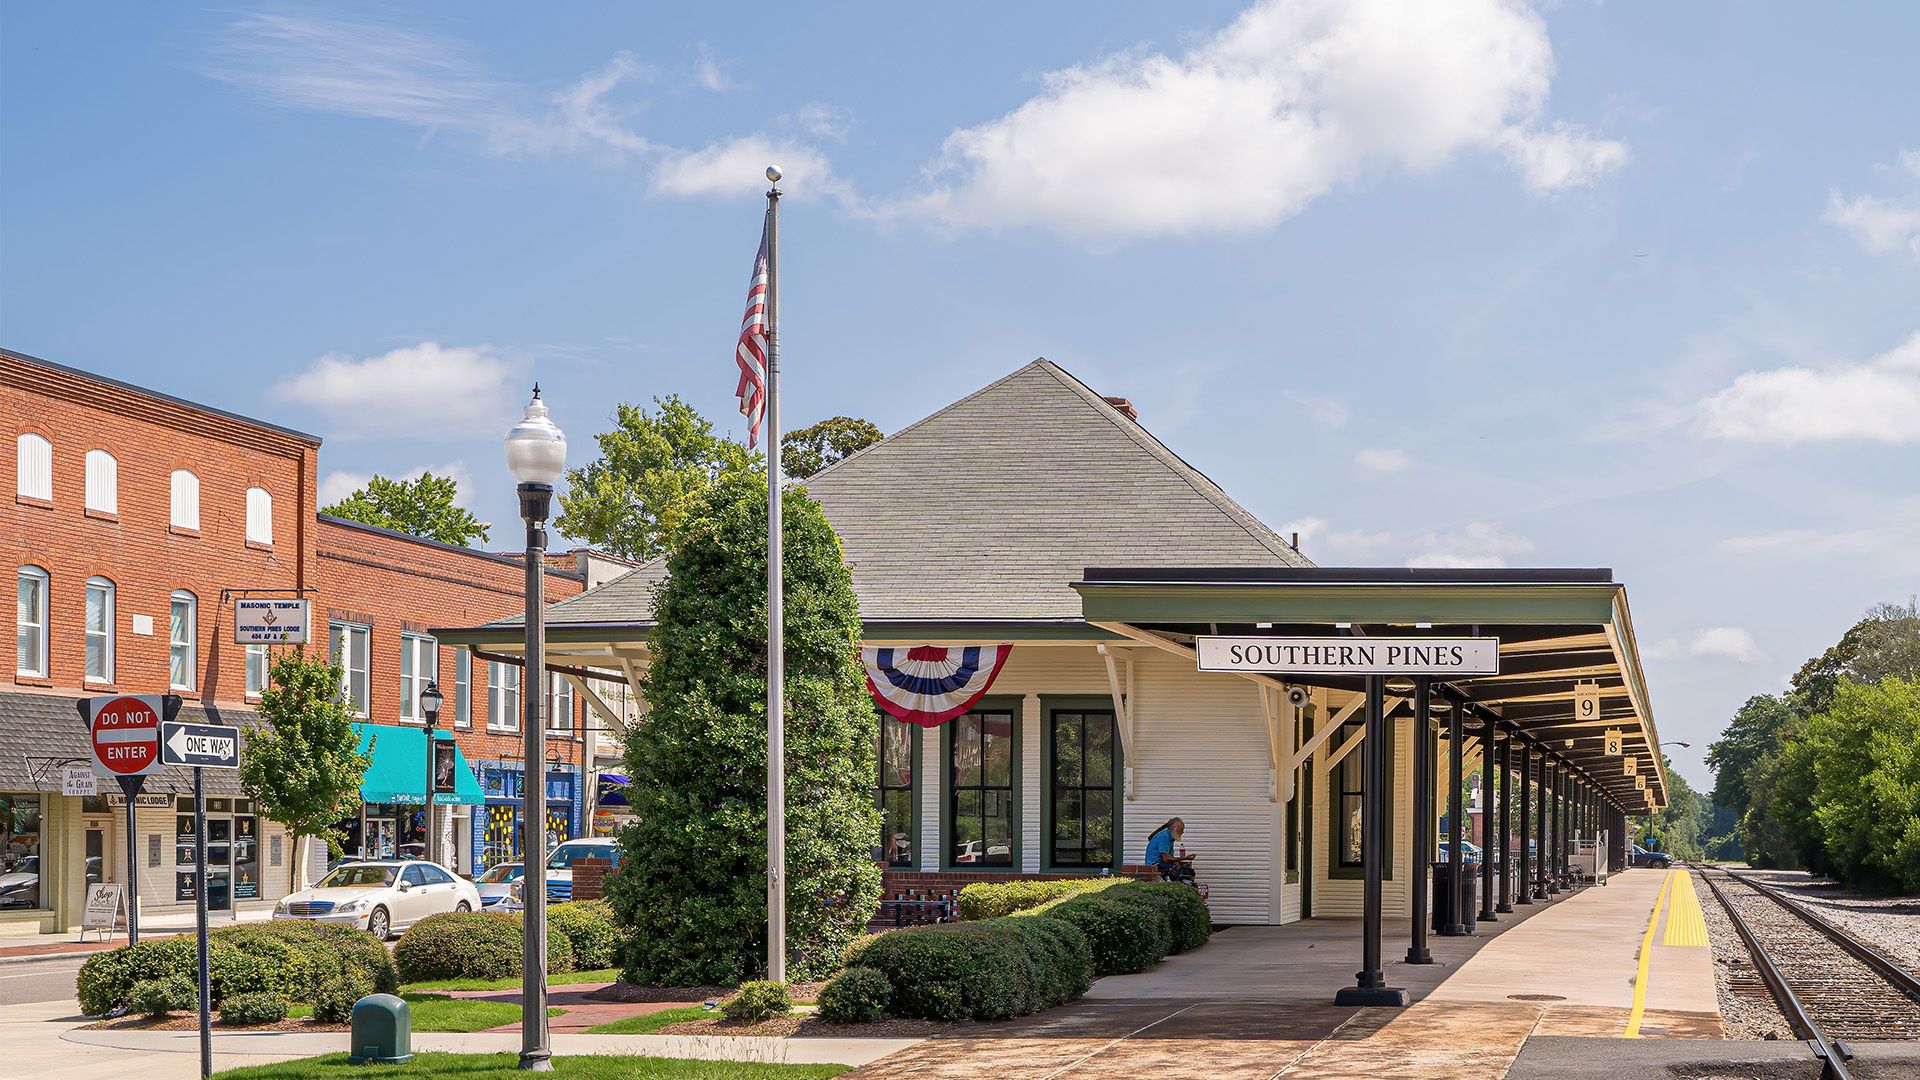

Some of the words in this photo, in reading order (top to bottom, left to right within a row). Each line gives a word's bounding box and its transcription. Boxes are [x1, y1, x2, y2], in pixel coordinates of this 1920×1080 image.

[1230, 644, 1376, 666] SOUTHERN
[1386, 646, 1463, 666] PINES
[1582, 700, 1593, 716] 9
[102, 712, 119, 725] DO
[126, 711, 151, 724] NOT
[186, 737, 206, 753] ONE
[210, 738, 231, 754] WAY
[1609, 741, 1617, 752] 8
[107, 746, 147, 760] ENTER
[69, 770, 90, 779] AGAINST
[1627, 765, 1633, 774] 7
[75, 780, 93, 788] GRAIN
[1637, 781, 1643, 789] 6
[118, 796, 147, 805] MANIC
[147, 796, 168, 805] LODGE
[94, 886, 113, 901] Shop
